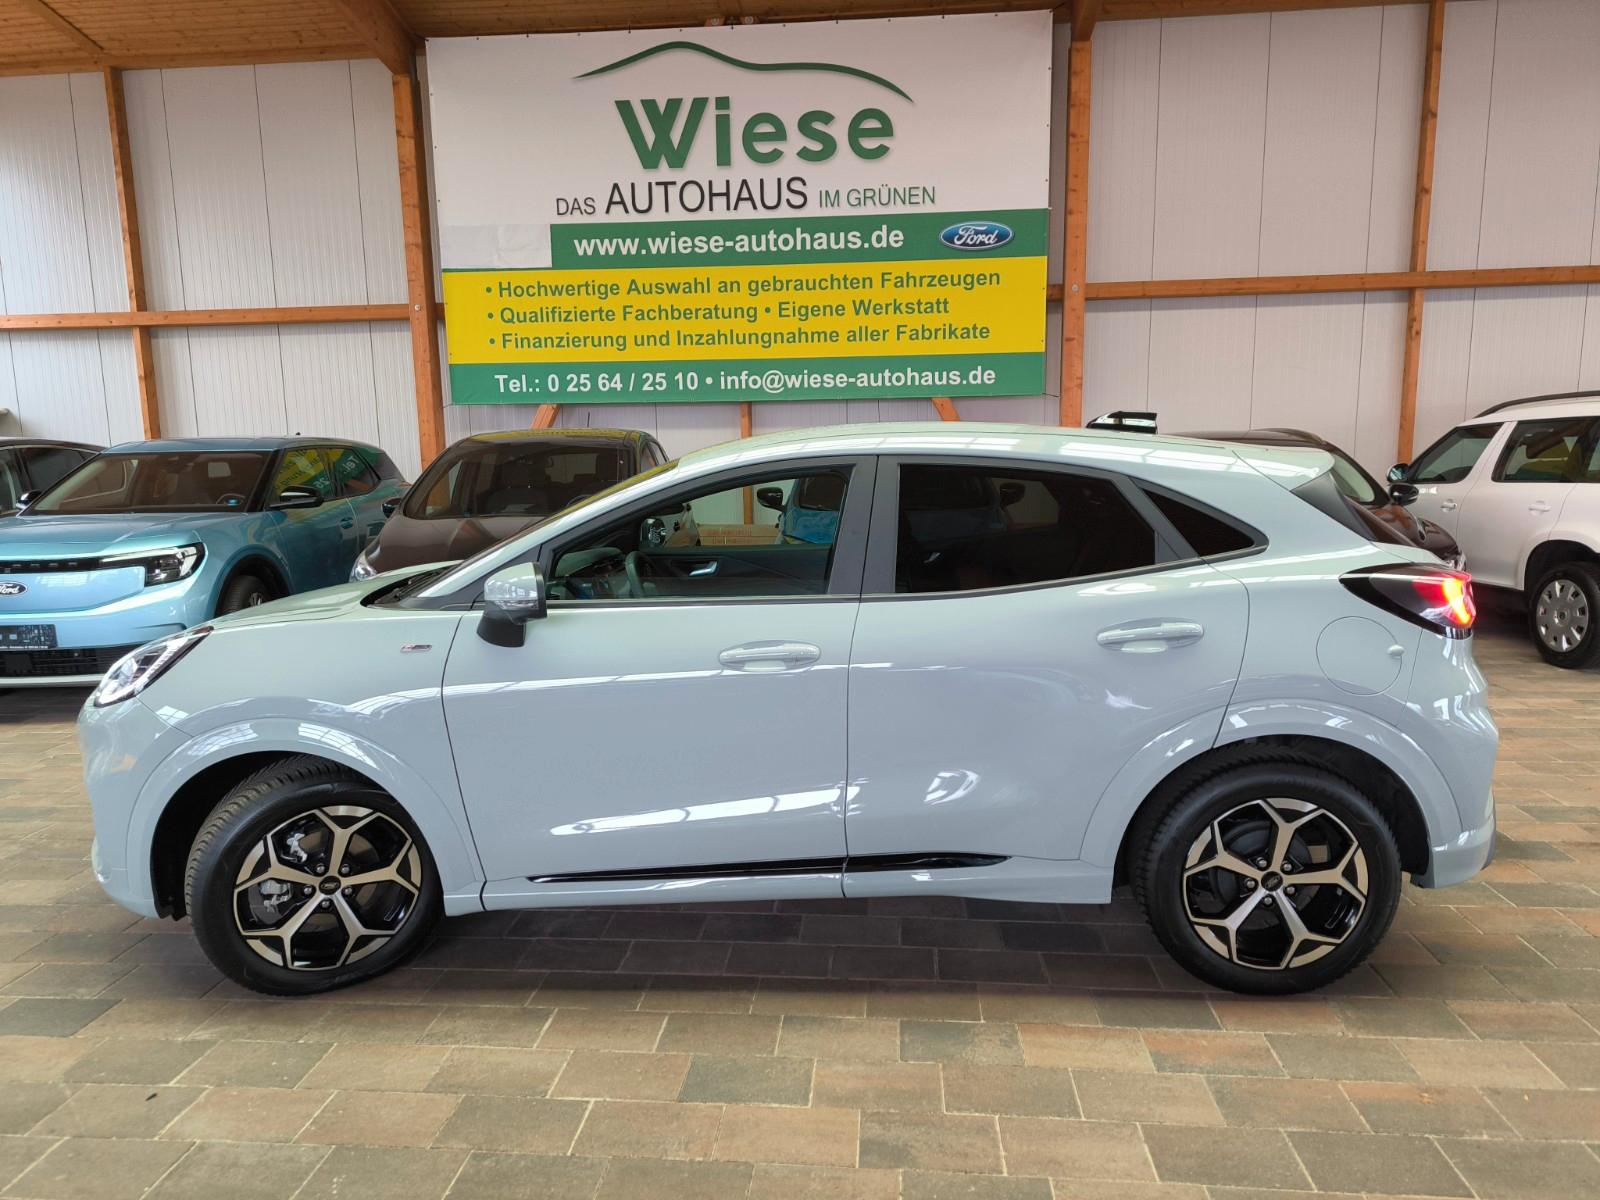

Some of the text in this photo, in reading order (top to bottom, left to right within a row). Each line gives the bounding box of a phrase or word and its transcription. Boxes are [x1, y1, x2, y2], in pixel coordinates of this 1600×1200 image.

[614, 96, 894, 170] Wiese
[556, 176, 936, 215] DAS AUTOHAUS IM GRÜNEN
[573, 224, 905, 256] www.wiese-autohaus.de
[953, 225, 999, 245] Ford
[498, 271, 1001, 300] Hochwertige Auswahl an gebrauchten Fahrzeugen
[500, 297, 950, 324] Qualifizierte Fachberatung Eigene Werkstatt
[502, 323, 990, 351] Finanzierung und Inzahlungnahme aller Fabrikate
[495, 366, 996, 394] Tel.: 0 25 64 / 25 10 info@wiese-autohaus.de
